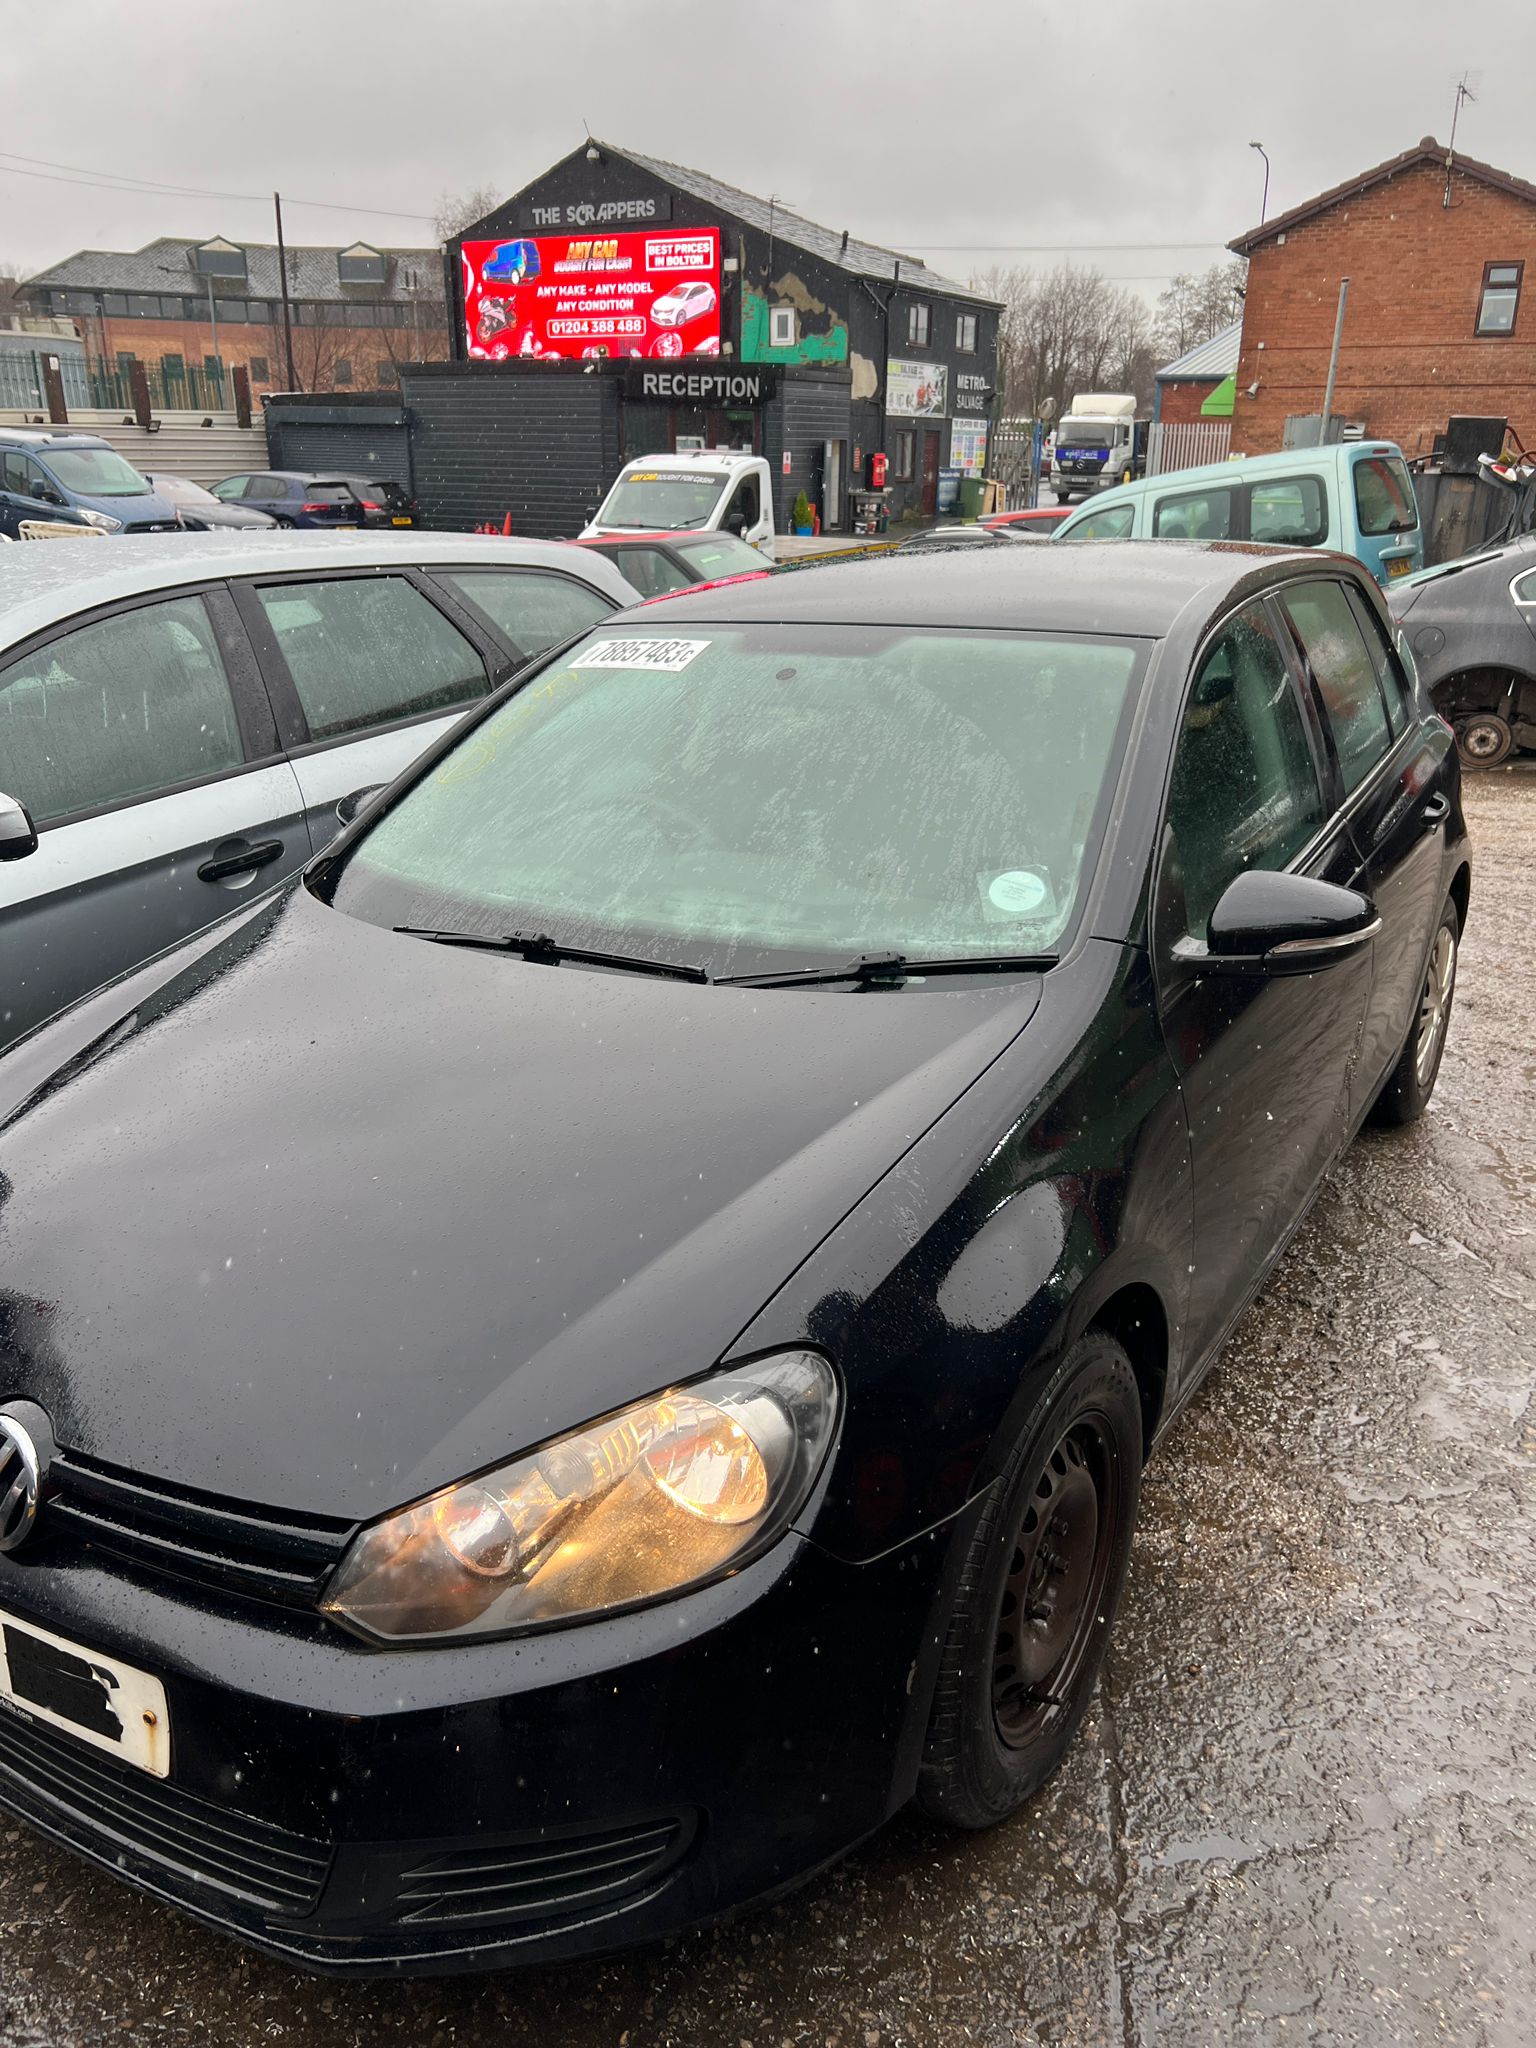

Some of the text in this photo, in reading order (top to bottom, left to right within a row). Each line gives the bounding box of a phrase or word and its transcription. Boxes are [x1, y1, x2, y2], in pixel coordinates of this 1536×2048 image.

[532, 199, 656, 226] THE SCRAPPERS
[566, 239, 619, 260] ANY CAR
[649, 242, 711, 256] BEST PRICES
[654, 255, 704, 267] IN BOLTON
[537, 286, 558, 298] ANY
[558, 284, 587, 296] MAKE
[595, 283, 617, 295] ANY
[617, 281, 654, 294] MODEL
[555, 299, 634, 313] ANY CONDITION
[551, 319, 642, 334] 01204 388 488
[643, 373, 760, 398] RECEPTION
[956, 374, 985, 391] METRO
[956, 394, 984, 410] SALVAGE
